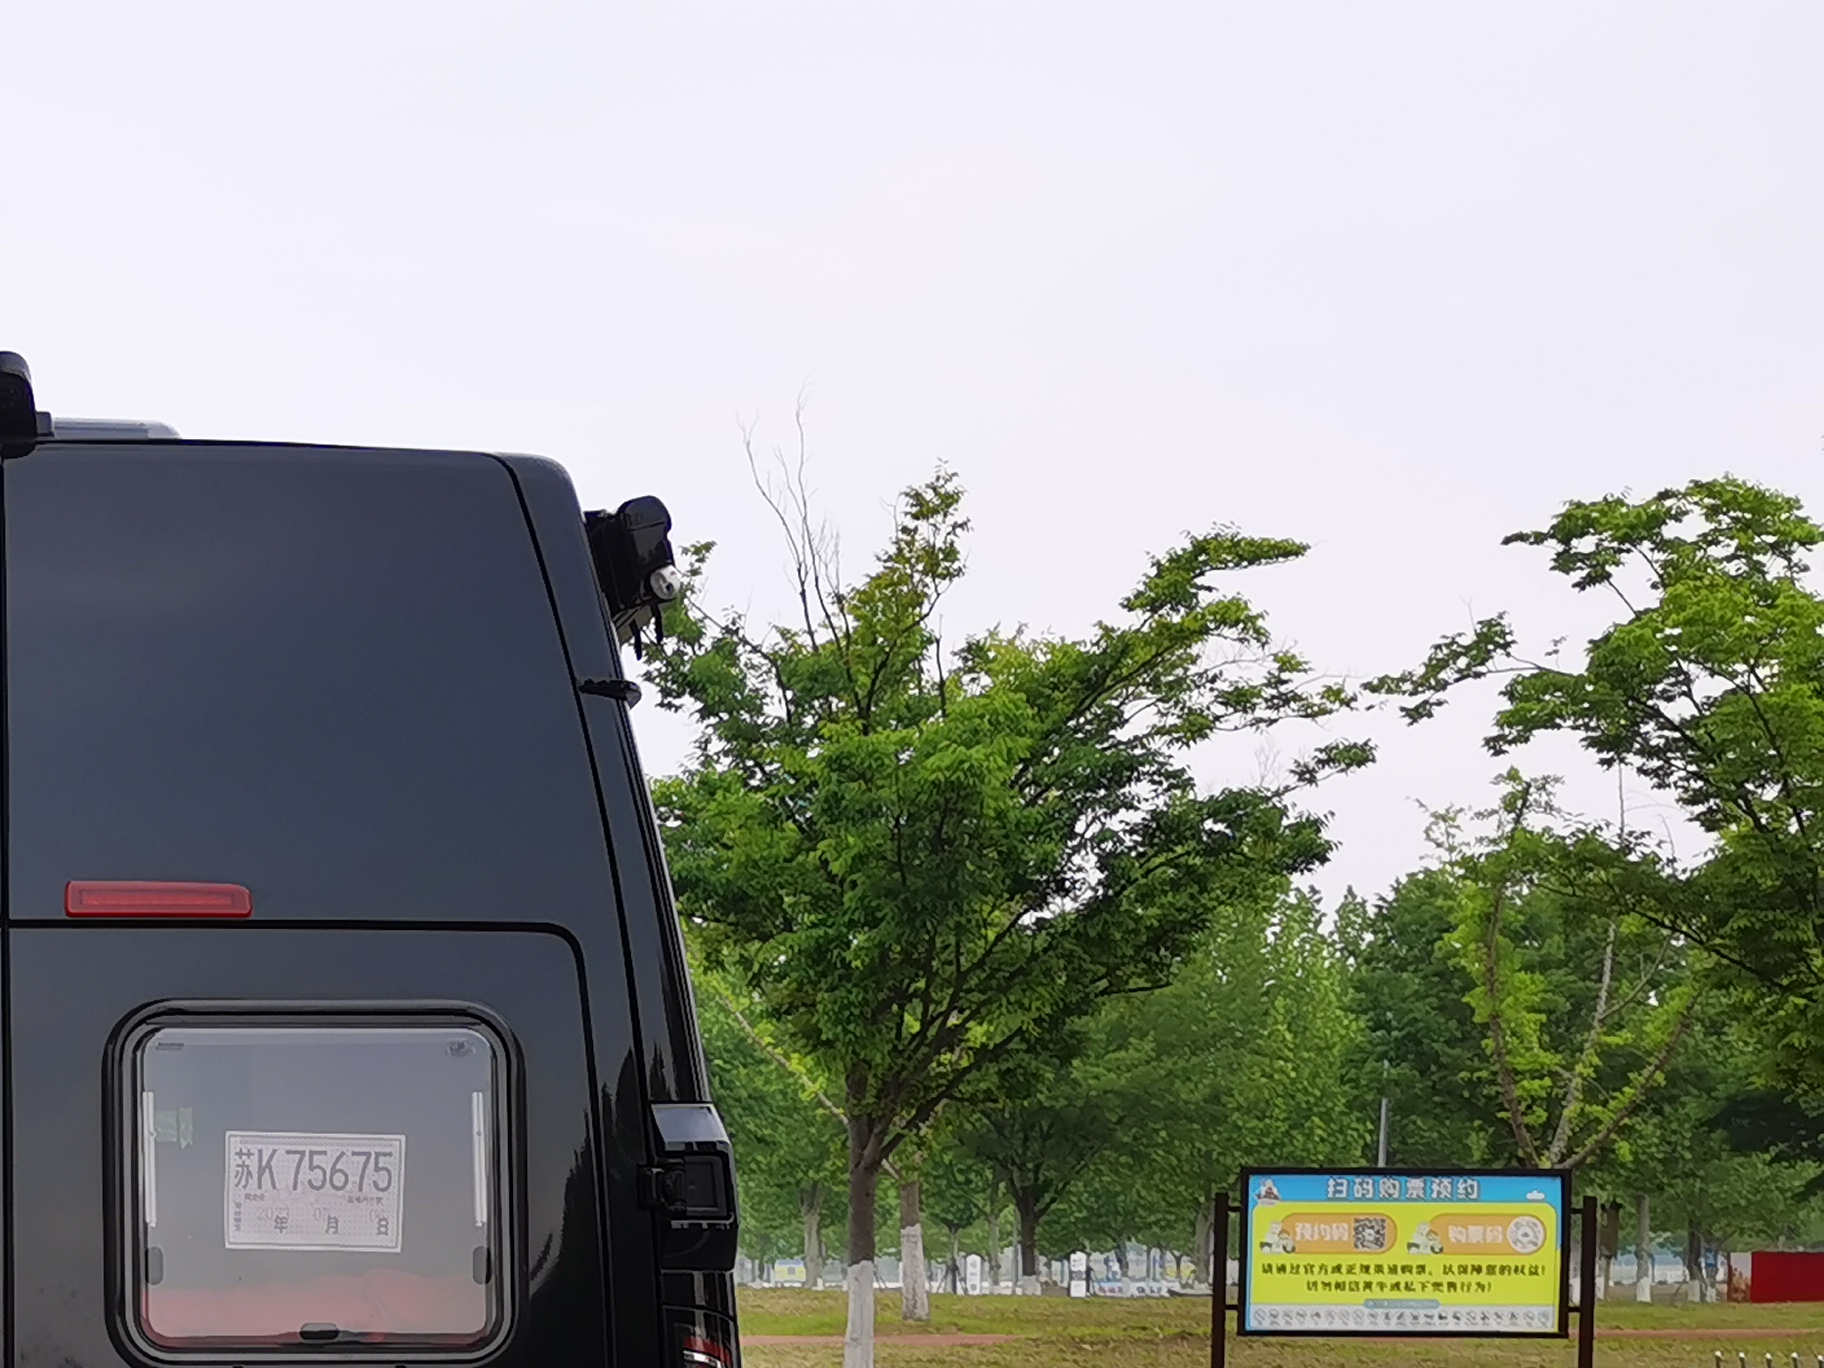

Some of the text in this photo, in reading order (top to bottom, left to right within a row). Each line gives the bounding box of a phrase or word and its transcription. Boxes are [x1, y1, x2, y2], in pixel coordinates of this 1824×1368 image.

[234, 1148, 393, 1193] 苏K75675
[1326, 1176, 1480, 1200] 扫码购票预约
